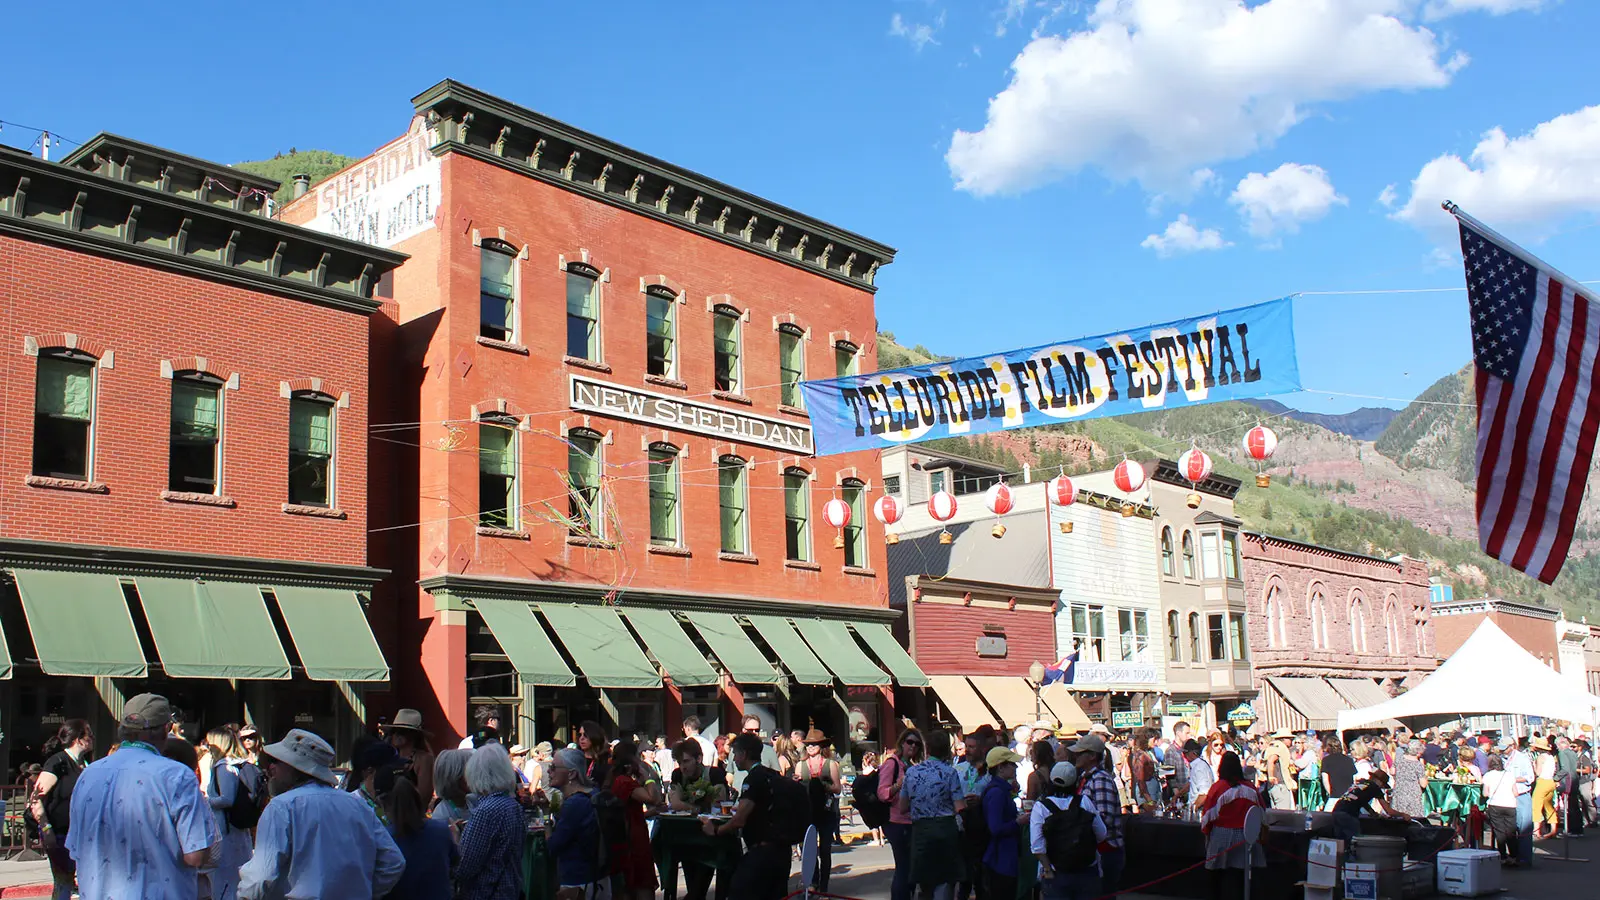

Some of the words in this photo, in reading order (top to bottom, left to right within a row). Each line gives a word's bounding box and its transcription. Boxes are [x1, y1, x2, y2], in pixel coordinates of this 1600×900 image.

[321, 131, 433, 214] SHERIDAN
[386, 183, 434, 241] HOTEL
[842, 367, 1005, 437] TELLURIDE
[1008, 351, 1095, 412] FILM
[1096, 323, 1262, 401] FESTIVAL
[576, 382, 646, 415] NEW
[655, 400, 806, 447] SHERIDAN
[1133, 669, 1155, 681] TODAY
